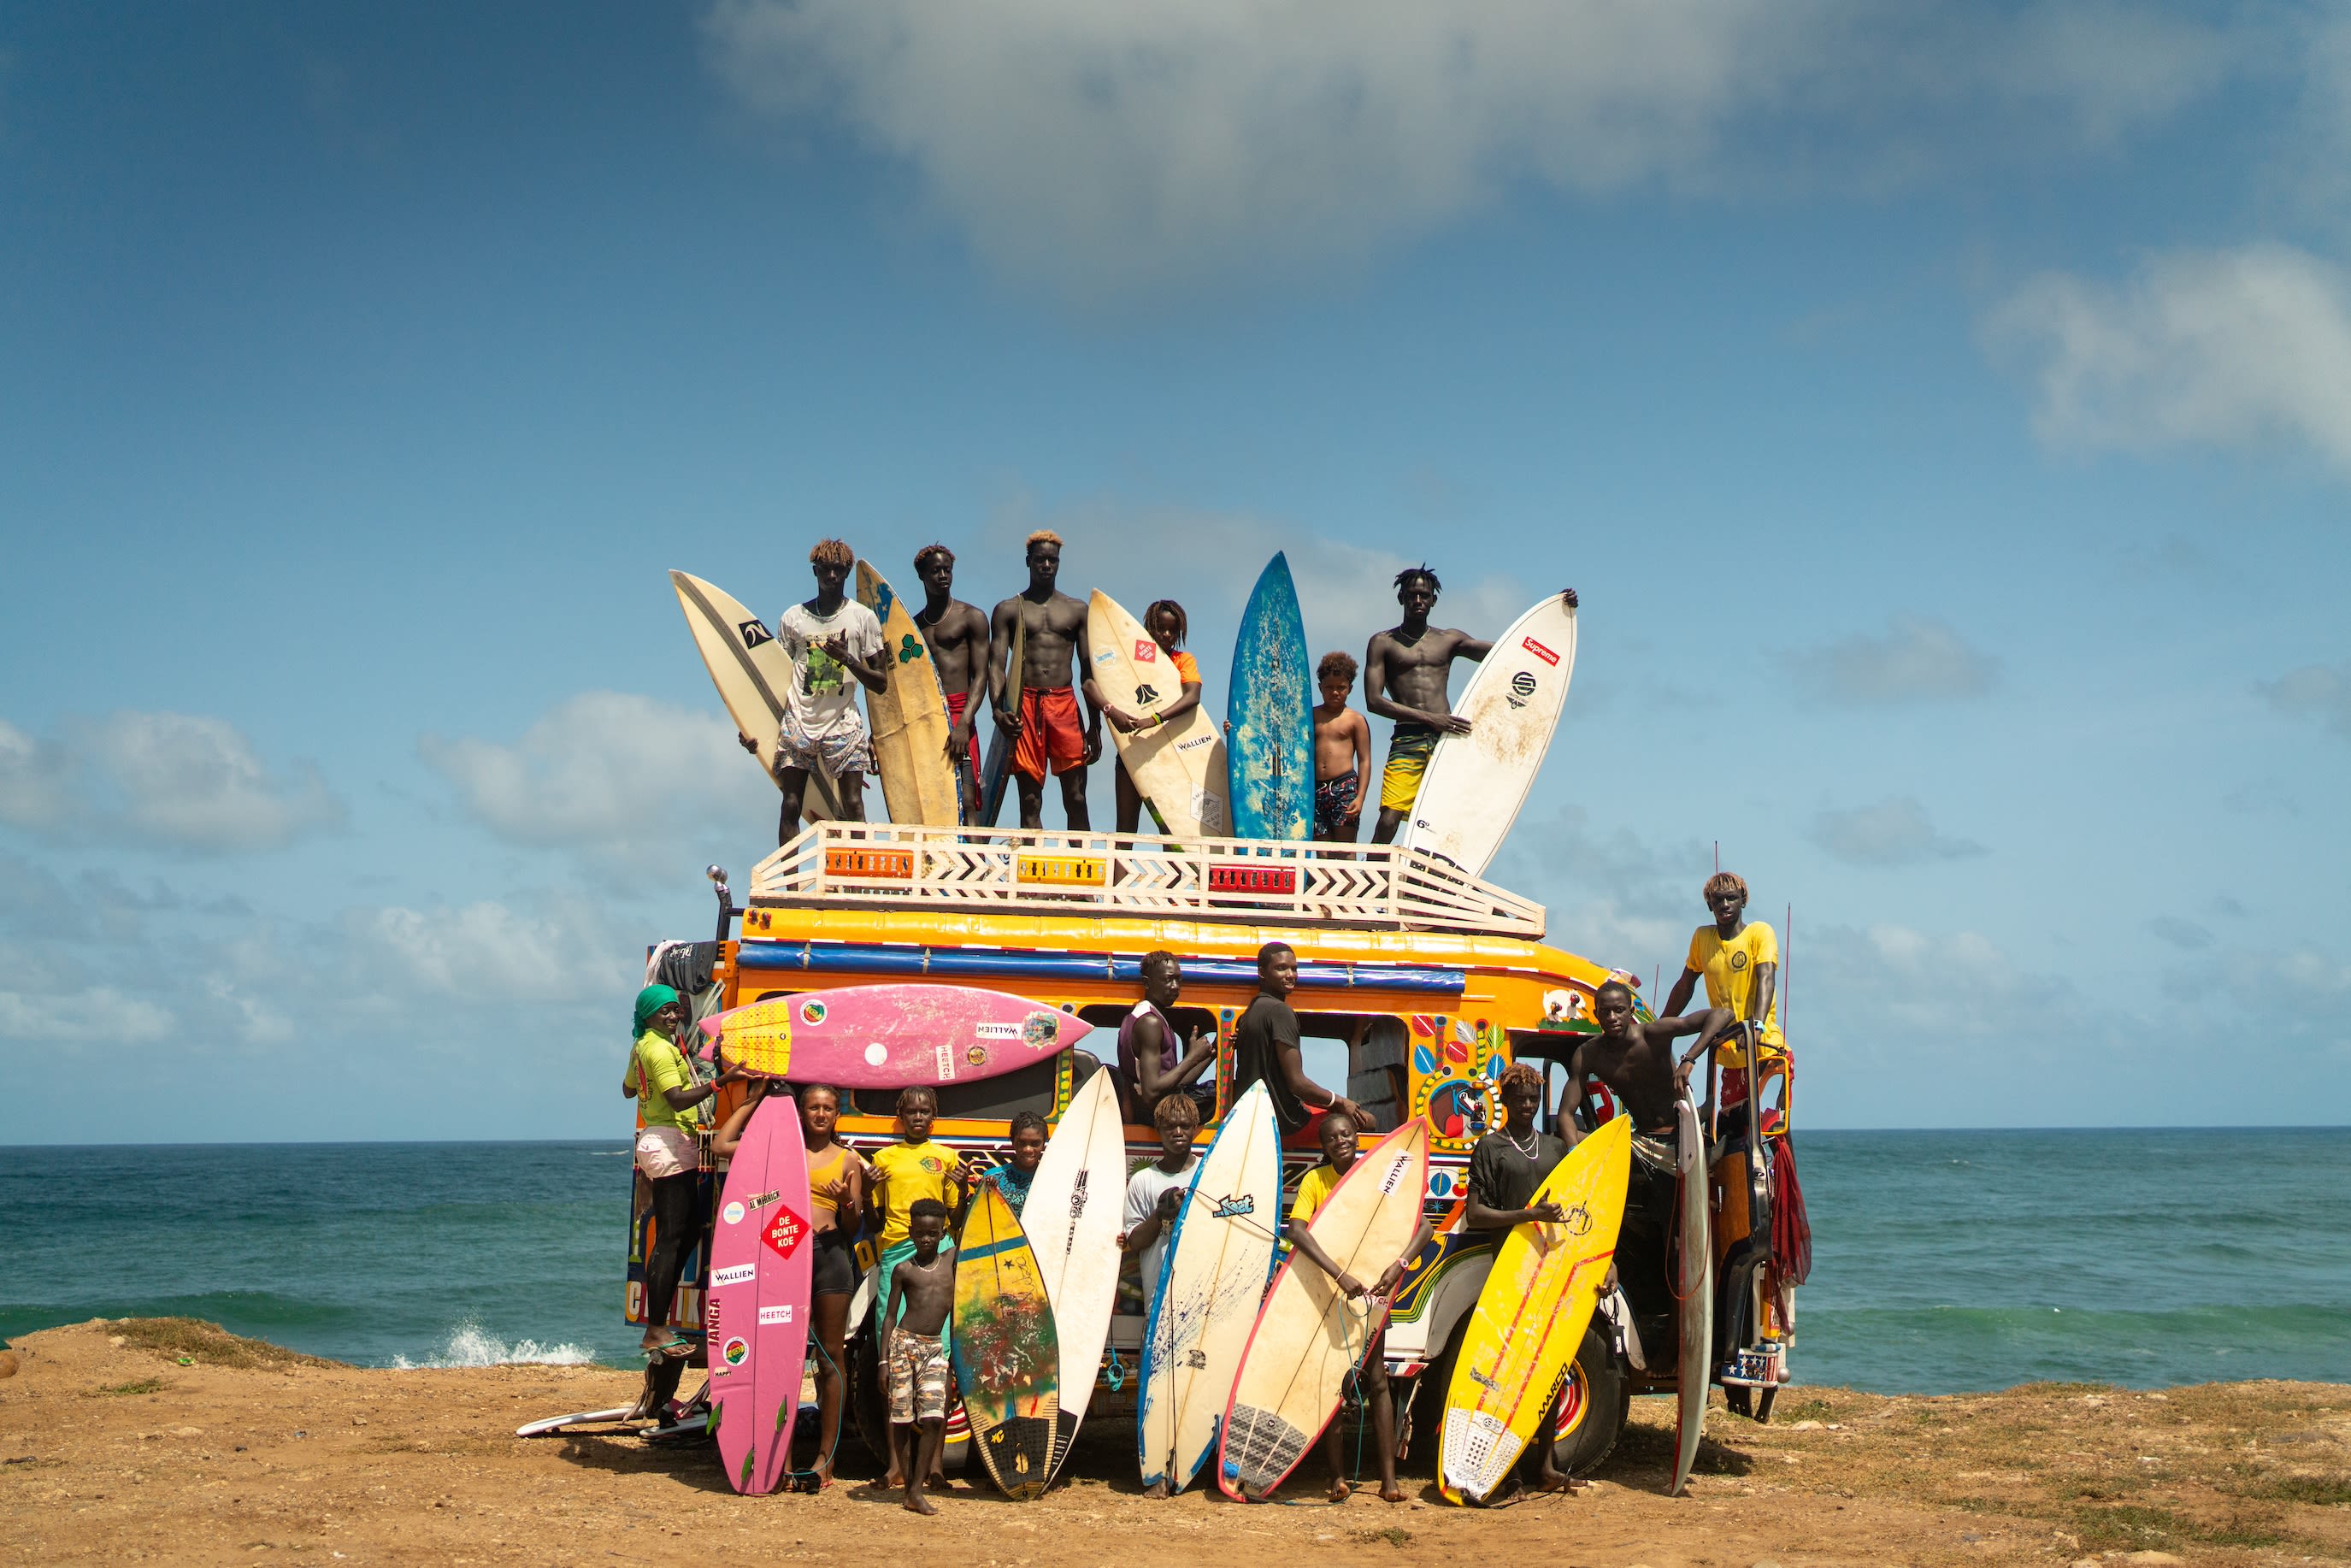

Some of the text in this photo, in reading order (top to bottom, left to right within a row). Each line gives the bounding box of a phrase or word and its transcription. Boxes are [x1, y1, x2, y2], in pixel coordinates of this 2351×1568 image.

[1524, 638, 1557, 663] Supreme
[1177, 735, 1211, 751] WALLIEN
[978, 1026, 1017, 1035] WALLIEN
[941, 1046, 950, 1079] HEETCH
[1383, 1156, 1408, 1194] WALLIEN
[757, 1190, 780, 1206] MERRICK
[779, 1216, 790, 1226] DE
[771, 1224, 798, 1239] BONTE
[777, 1236, 794, 1248] KOE
[716, 1270, 754, 1282] WALLIEN
[760, 1310, 791, 1319] HEETCH
[708, 1298, 720, 1348] JANGA
[1538, 1362, 1568, 1422] MARCO
